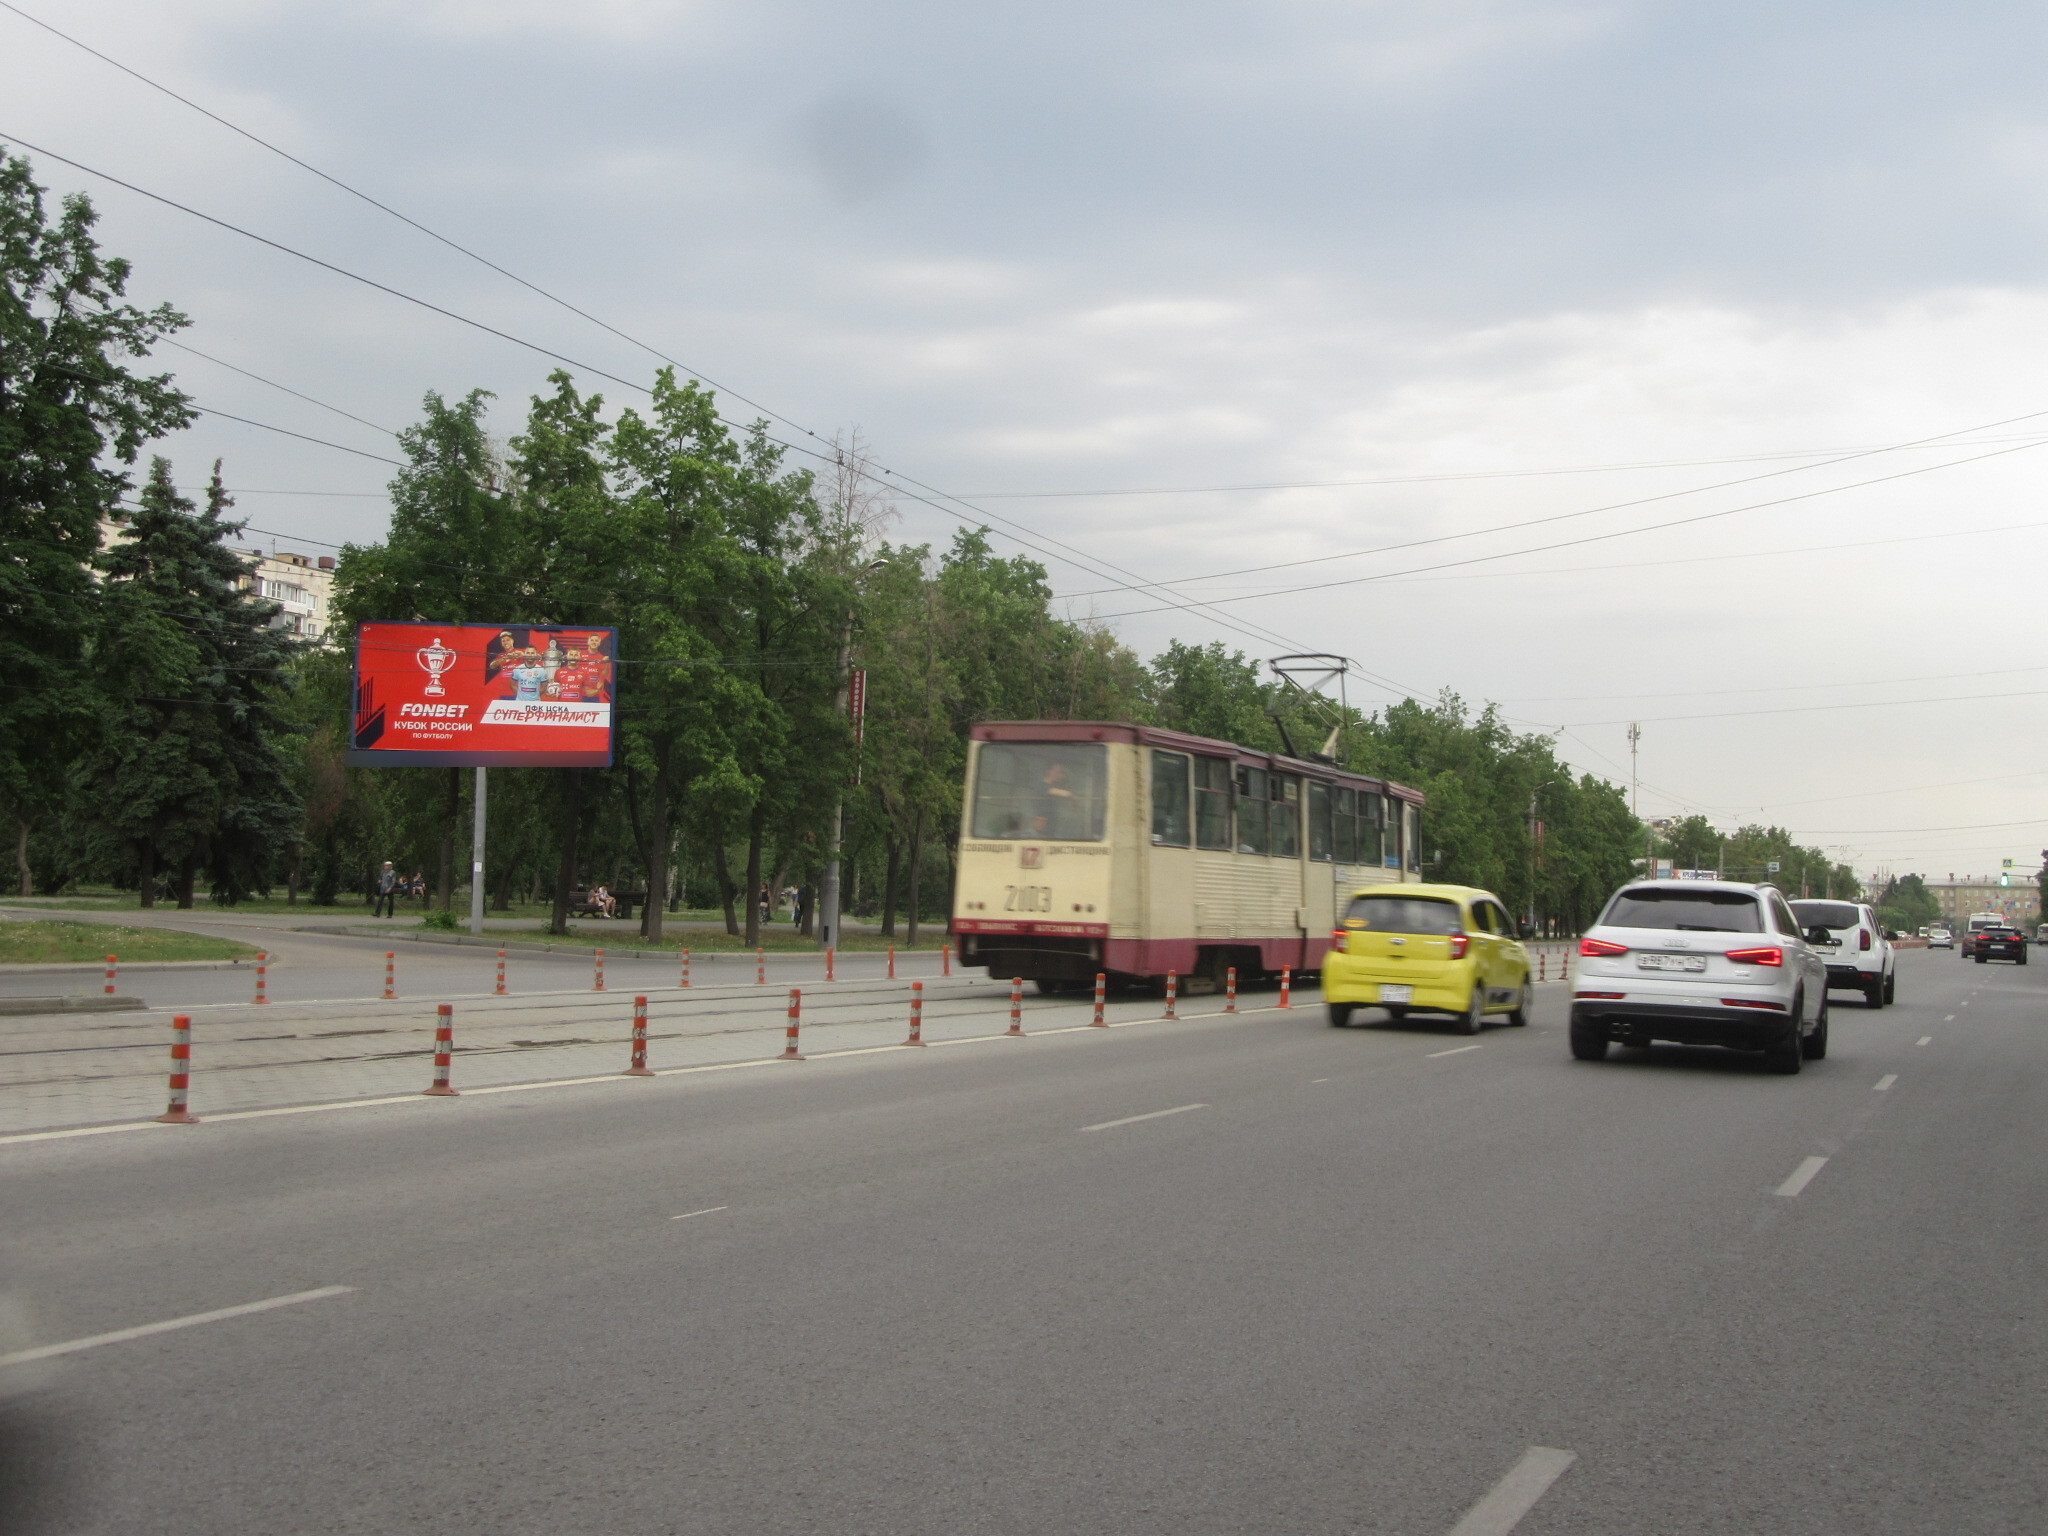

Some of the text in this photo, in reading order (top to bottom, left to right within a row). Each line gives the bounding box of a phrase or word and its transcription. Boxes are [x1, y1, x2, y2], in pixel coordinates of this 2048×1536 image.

[401, 703, 469, 718] FONBET
[493, 709, 600, 724] СУПЕРФИНАЛИСТ
[546, 705, 569, 713] ЦСКА
[394, 721, 473, 731] КУБОК РОССИИ
[1021, 847, 1040, 866] 17
